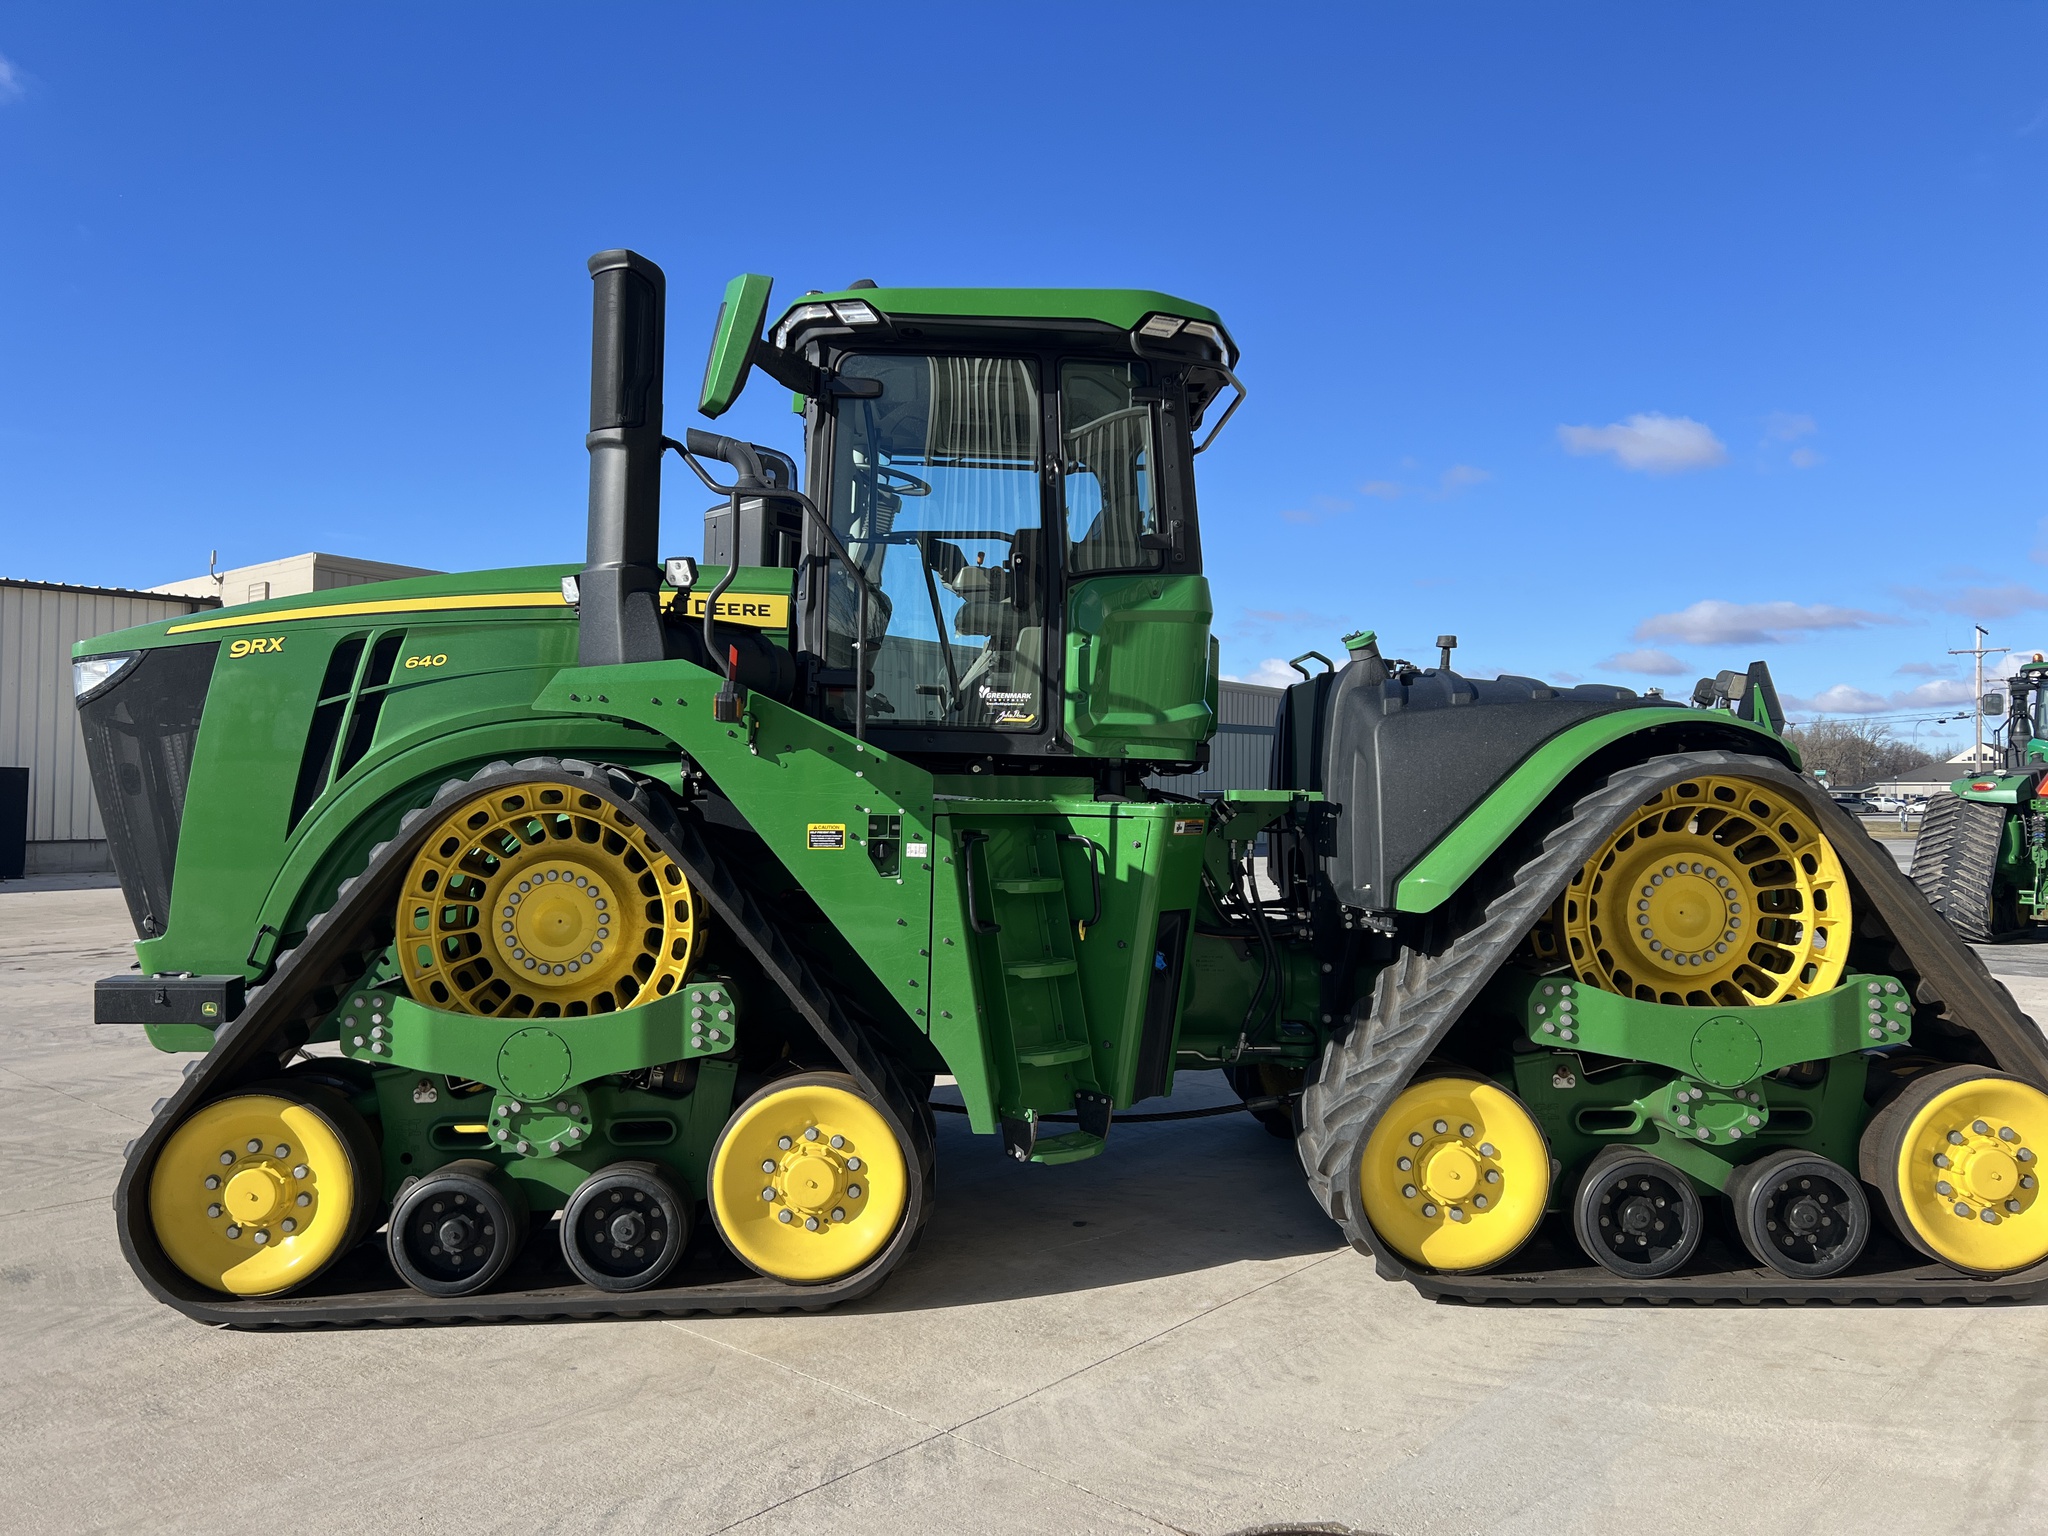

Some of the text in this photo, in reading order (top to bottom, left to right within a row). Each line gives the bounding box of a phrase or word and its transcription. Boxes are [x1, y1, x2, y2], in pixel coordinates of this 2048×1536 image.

[695, 600, 771, 616] DEERE
[229, 636, 286, 659] 9RX
[404, 654, 448, 669] 640
